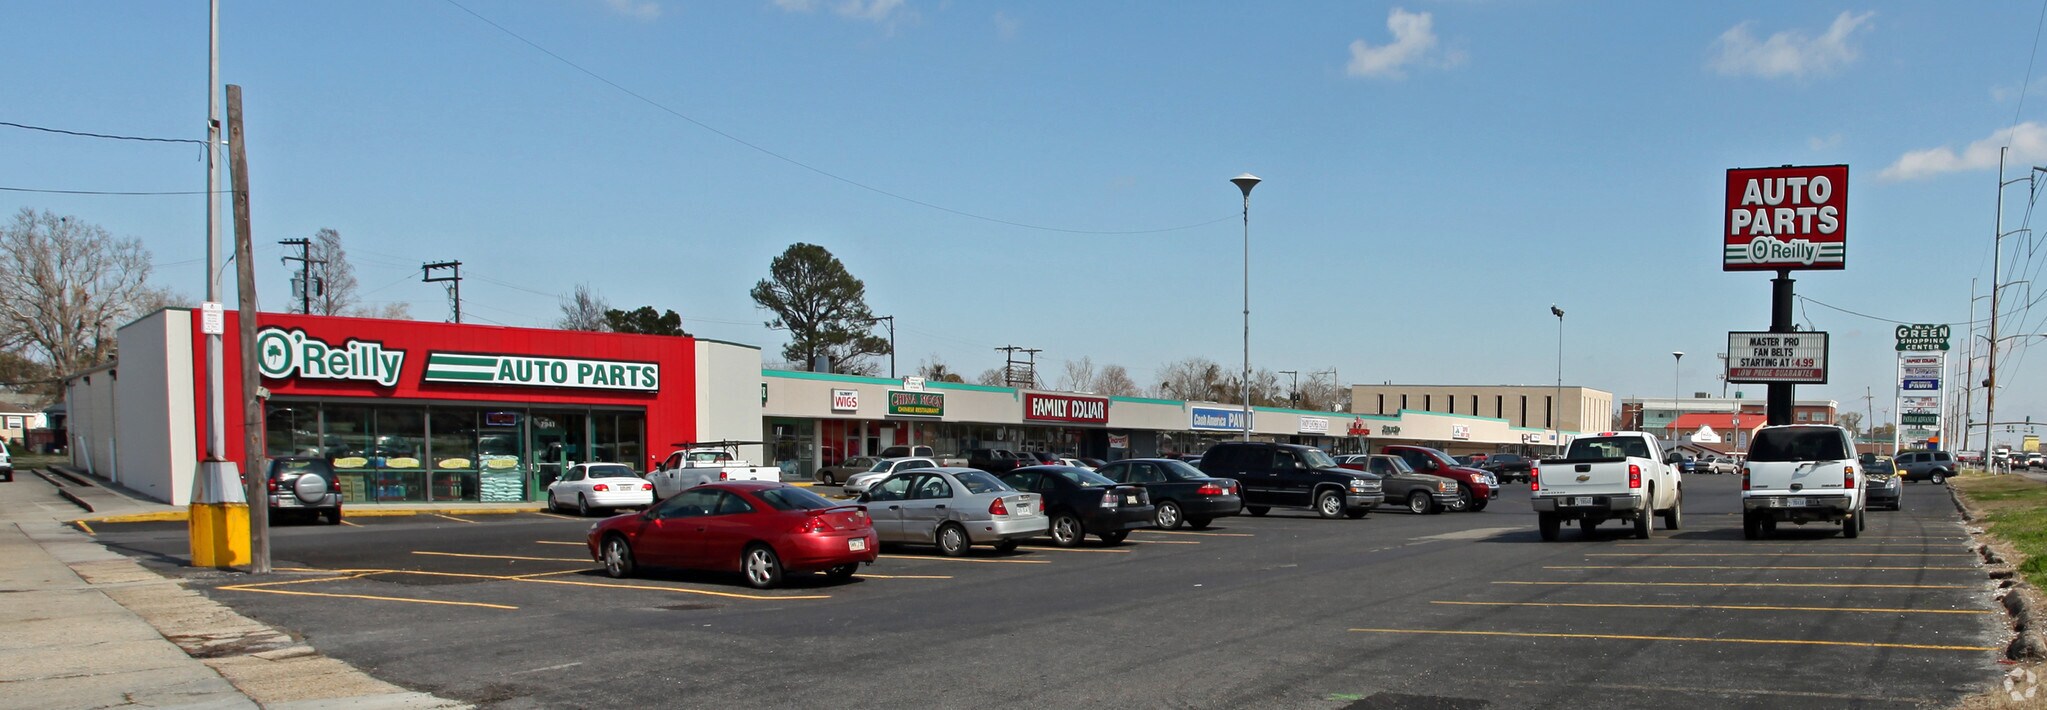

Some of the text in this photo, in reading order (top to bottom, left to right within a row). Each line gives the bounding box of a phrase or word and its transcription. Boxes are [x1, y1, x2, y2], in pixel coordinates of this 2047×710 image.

[1741, 175, 1832, 206] AUTO
[1731, 205, 1839, 236] PARTS
[1752, 239, 1814, 260] O'Reilly
[1898, 327, 1948, 338] GREEN
[1749, 337, 1800, 346] MASTER PRO
[257, 332, 400, 383] O'Reilly
[1753, 348, 1794, 357] FAN BELTS
[1740, 358, 1815, 367] STARTING AT $4.99
[498, 359, 656, 388] AUTO PARTS
[1736, 369, 1752, 377] LOW
[1753, 369, 1774, 377] PRICE
[835, 396, 858, 408] WIGS
[891, 392, 917, 406] CHINA
[1032, 397, 1105, 419] FAMILY DOLLAR
[1193, 413, 1207, 426] Cash
